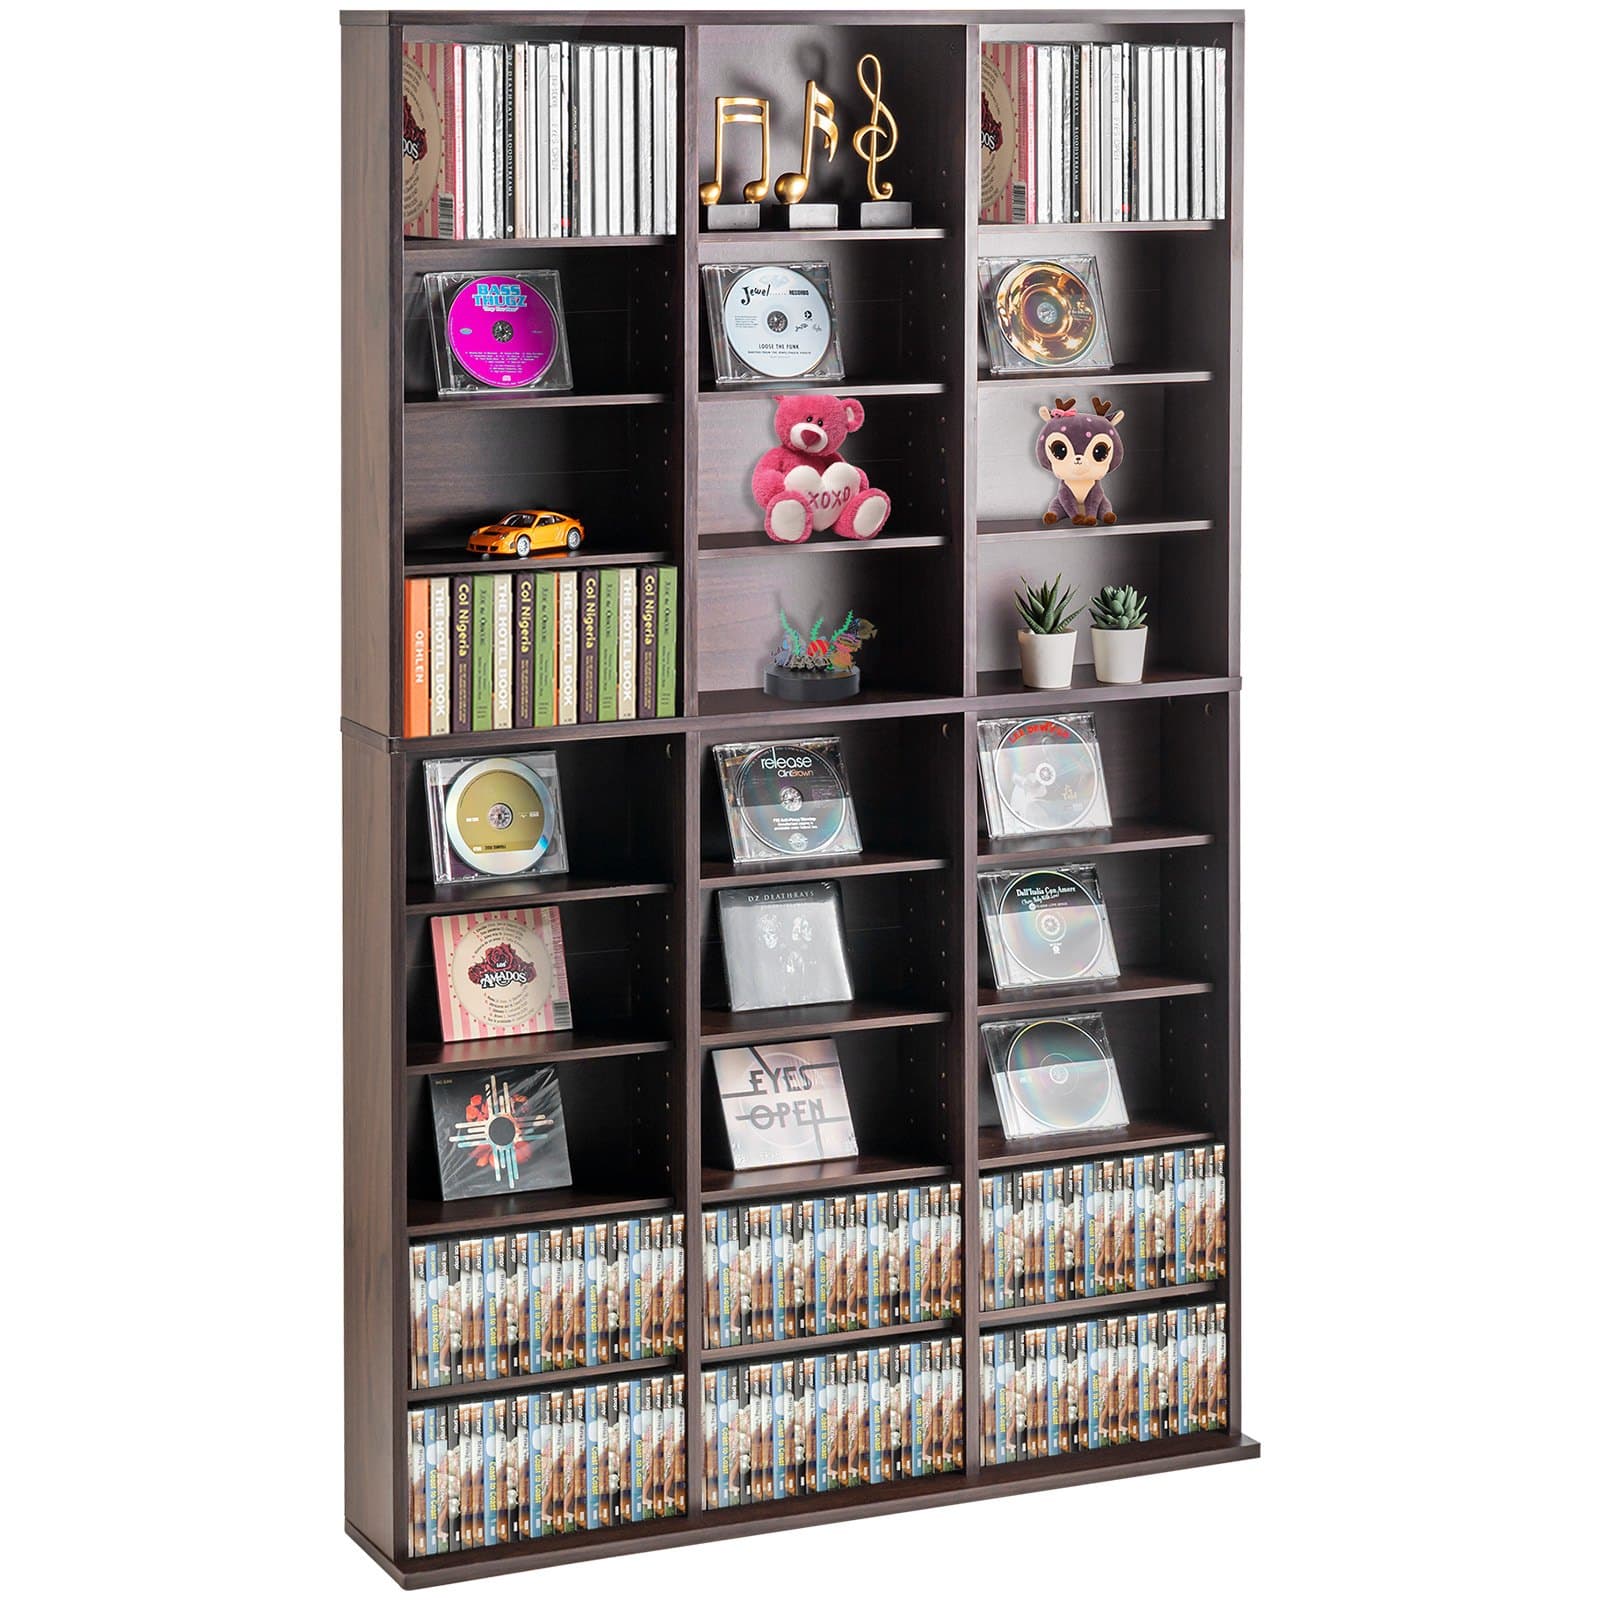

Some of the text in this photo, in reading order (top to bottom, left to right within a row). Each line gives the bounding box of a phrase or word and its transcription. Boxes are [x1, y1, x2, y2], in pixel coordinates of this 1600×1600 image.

[472, 294, 528, 307] THUGZ
[476, 283, 521, 296] BASS
[740, 284, 771, 306] Jewel
[807, 486, 851, 509] XOXO
[458, 583, 469, 606] Col
[520, 581, 531, 603] Col
[585, 578, 596, 599] Col
[644, 575, 655, 596] Col
[456, 609, 469, 657] Nigeria
[518, 606, 531, 653] Nigeria
[583, 602, 596, 649] Nigeria
[643, 599, 655, 645] Nigeria
[498, 583, 508, 710] THE HOTEL BOOK
[563, 581, 573, 706] THE HOTEL BOOK
[623, 577, 632, 701] THE HOTEL BOOK
[415, 630, 425, 684] OEHLEN
[434, 587, 445, 716] THE HOTEL BOOK
[760, 746, 813, 769] release
[480, 970, 528, 988] AMADOS
